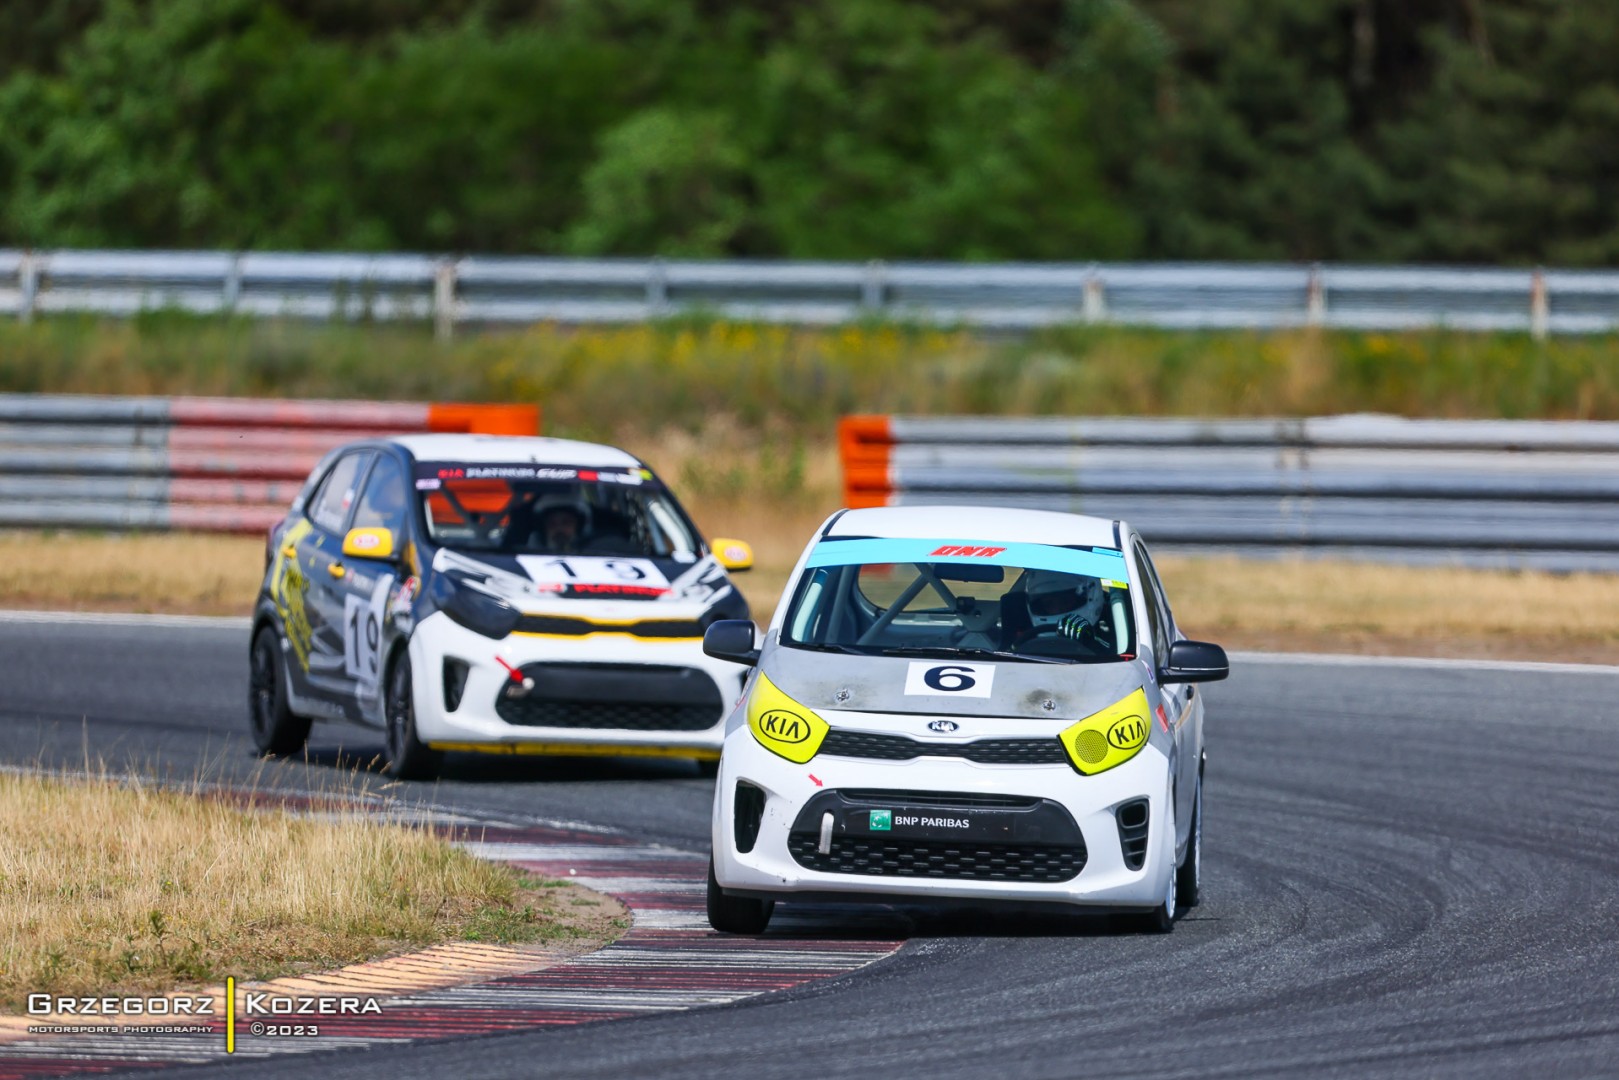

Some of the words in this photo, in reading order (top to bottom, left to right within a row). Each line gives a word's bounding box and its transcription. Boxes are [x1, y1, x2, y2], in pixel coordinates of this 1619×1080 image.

[350, 607, 379, 674] 19
[923, 665, 976, 692] 6
[766, 713, 800, 739] KIA
[930, 721, 957, 732] KIA
[1115, 720, 1146, 747] KIA
[894, 815, 919, 828] BNP
[920, 816, 970, 829] PARIBAS
